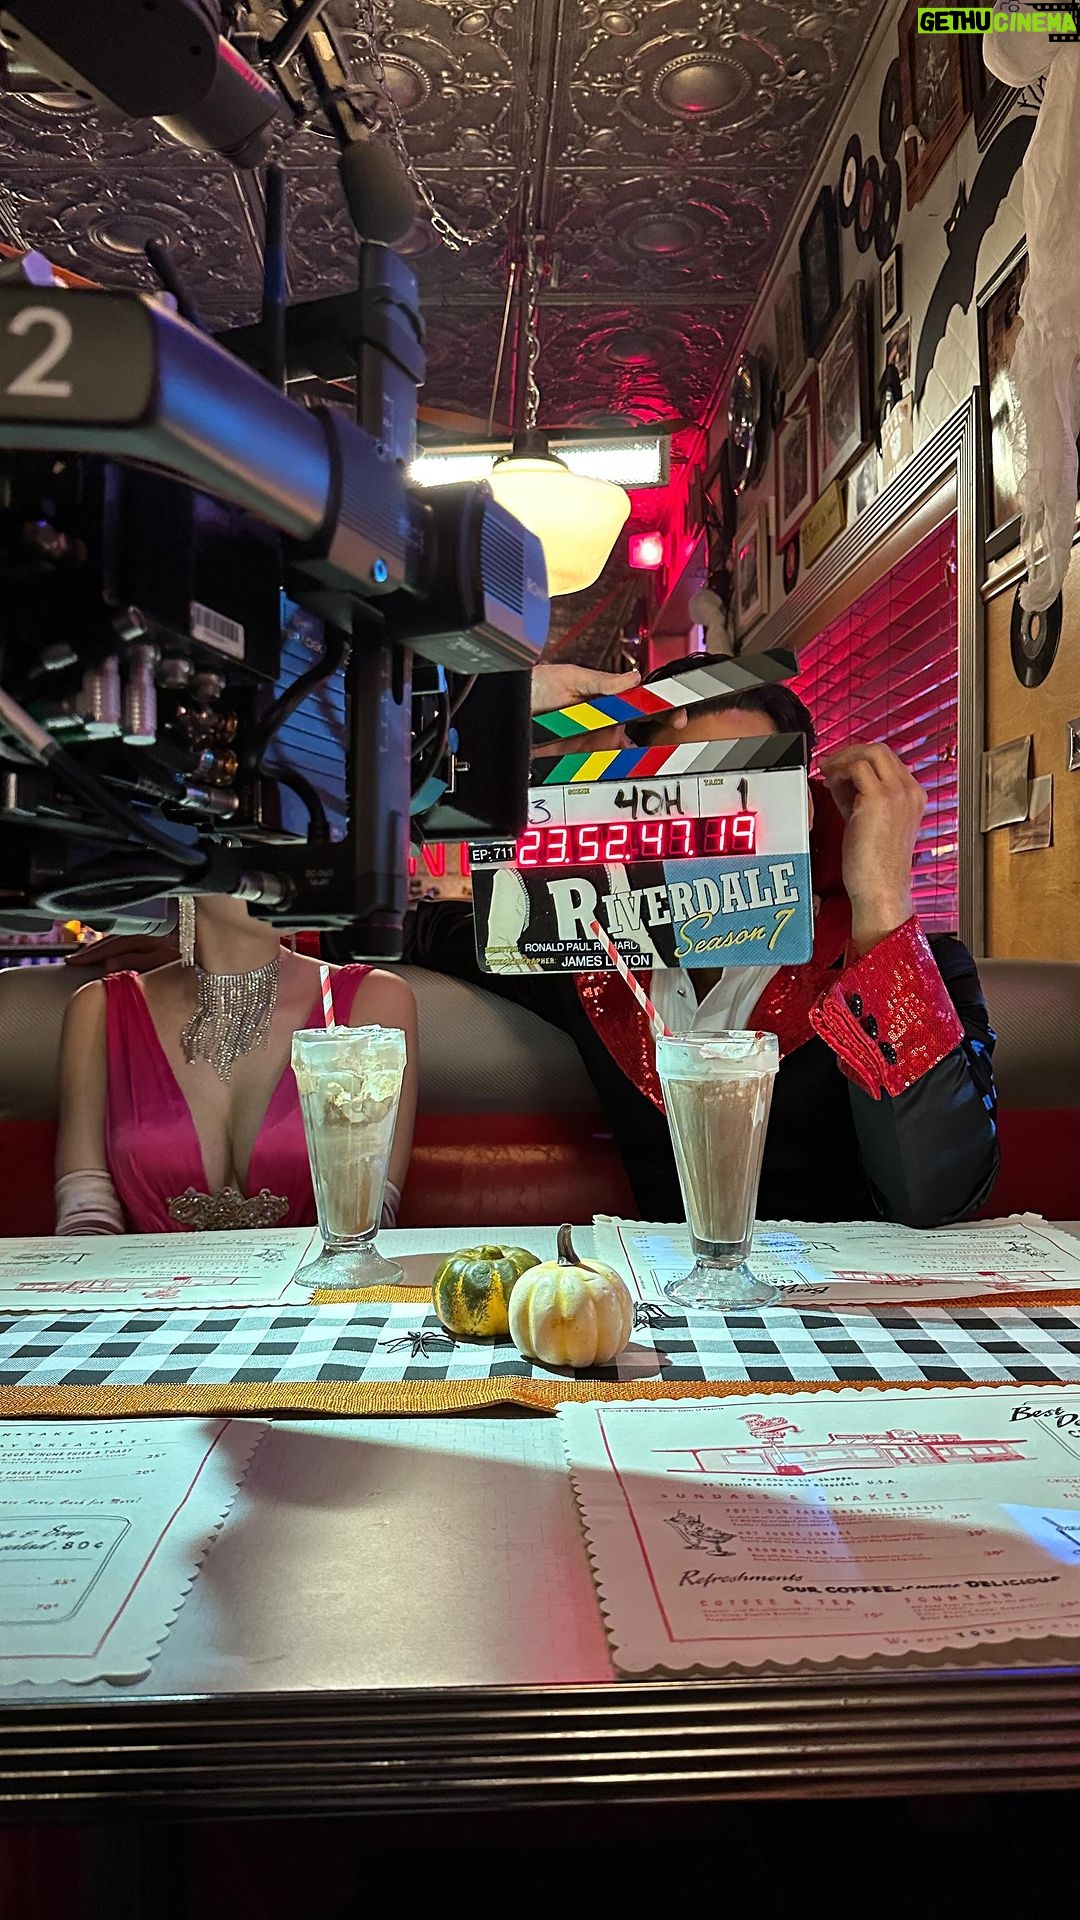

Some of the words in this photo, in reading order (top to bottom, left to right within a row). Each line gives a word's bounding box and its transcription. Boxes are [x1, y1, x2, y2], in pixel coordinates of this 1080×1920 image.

[7, 305, 73, 399] 2
[613, 781, 685, 820] 40H
[472, 849, 494, 862] EP:
[493, 847, 514, 859] 711
[547, 861, 800, 941] RIVERDALE
[674, 912, 766, 959] Season
[768, 908, 796, 950] 7
[525, 942, 563, 953] RONALD
[566, 941, 588, 951] PAUL
[561, 955, 602, 968] JAMES
[1008, 1406, 1066, 1423] Best
[33, 1438, 152, 1449] BREAKFAST
[818, 1491, 910, 1502] SHAKES
[679, 1569, 804, 1587] Refreshments
[782, 1585, 823, 1594] OUR
[826, 1584, 902, 1594] COFFEE
[964, 1575, 1062, 1588] DELICIOUS
[700, 1599, 777, 1607] COFFEE
[904, 1591, 1014, 1604] FOUNTAIN
[955, 1627, 997, 1639] YOU
